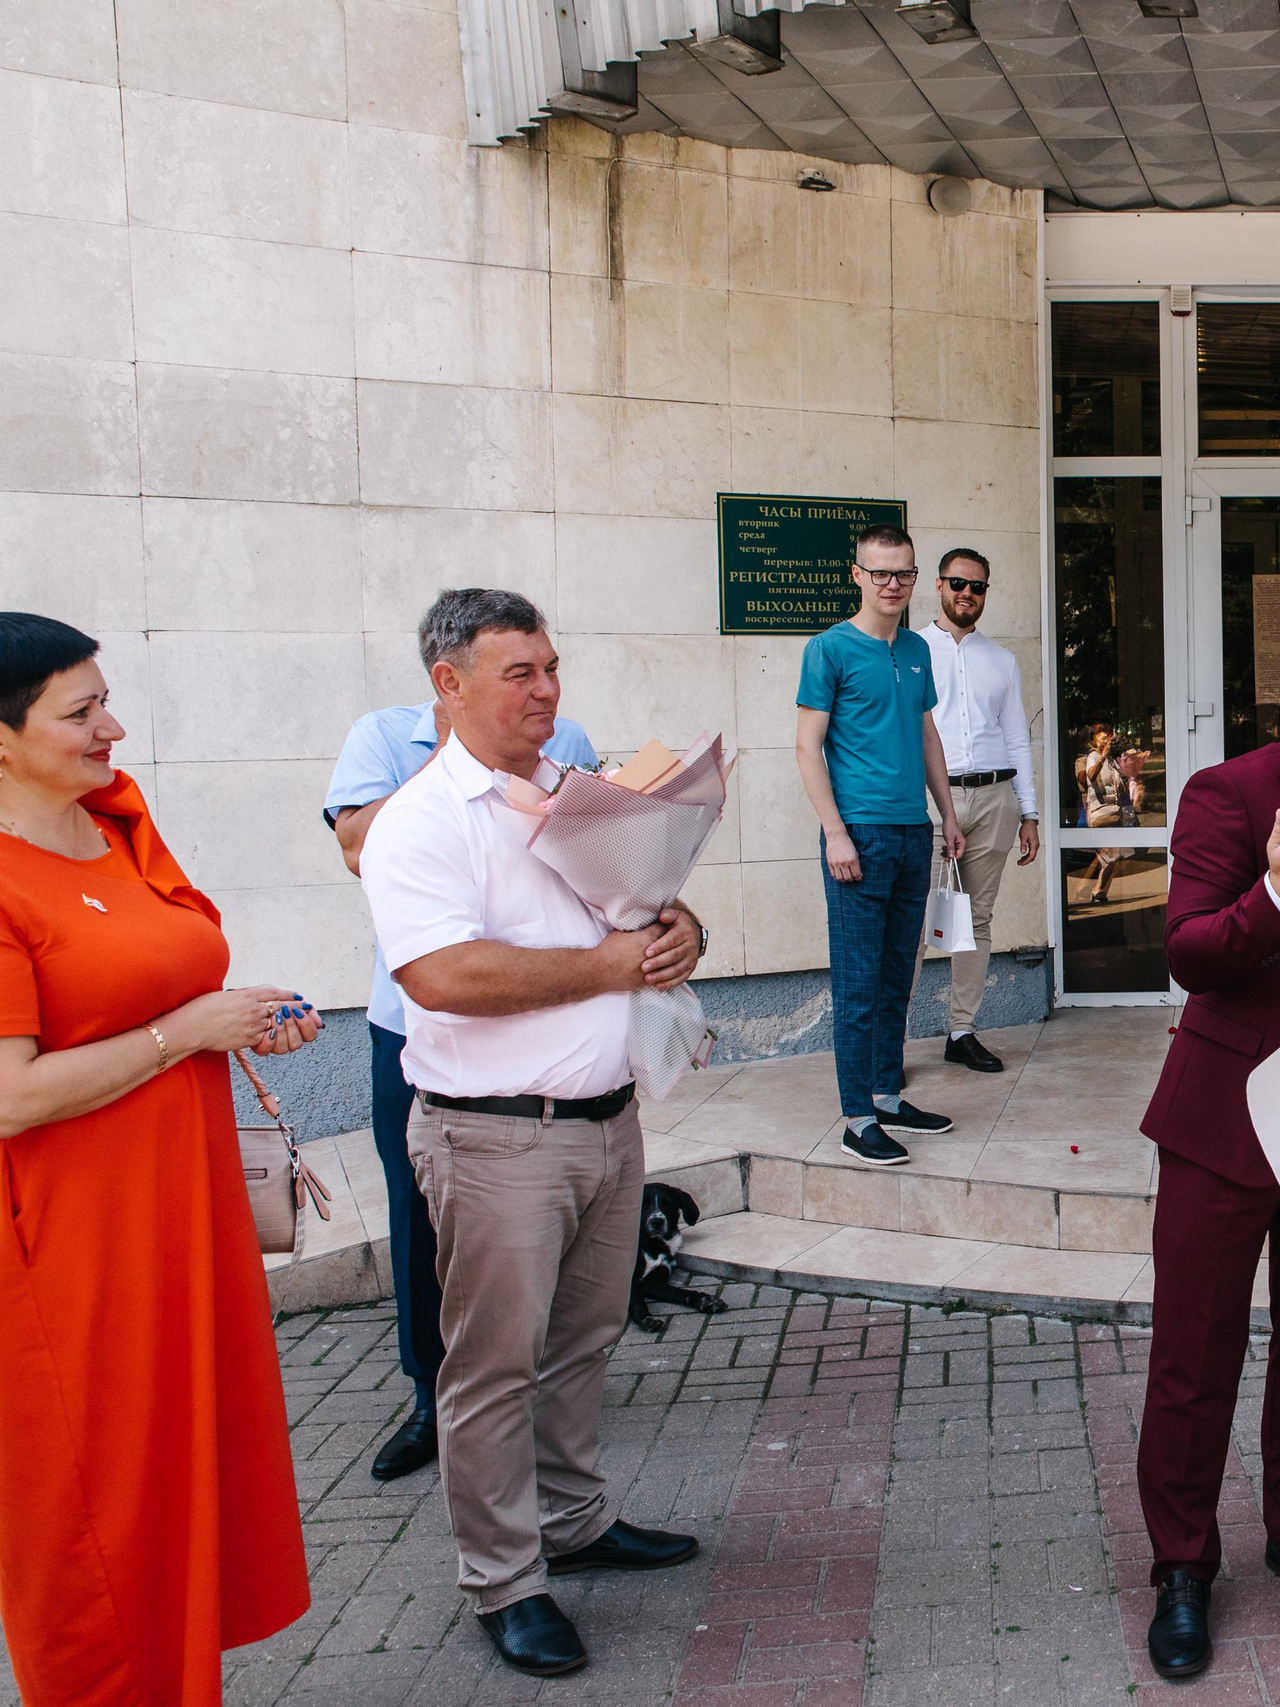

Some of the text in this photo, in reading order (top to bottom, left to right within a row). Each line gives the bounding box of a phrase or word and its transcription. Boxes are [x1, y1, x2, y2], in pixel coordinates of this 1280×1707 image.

[758, 505, 871, 520] ЧАСЫ ПРИЁМА:
[738, 520, 780, 529] вторник
[738, 532, 766, 541] среда
[739, 546, 778, 555] четверг
[763, 559, 813, 568] перерыв:
[729, 571, 841, 584] РЕГИСТРАЦИЯ
[768, 587, 819, 595] пятница,
[746, 600, 841, 613] ВЫХОДНЫЕ
[744, 616, 814, 625] воскресенье,
